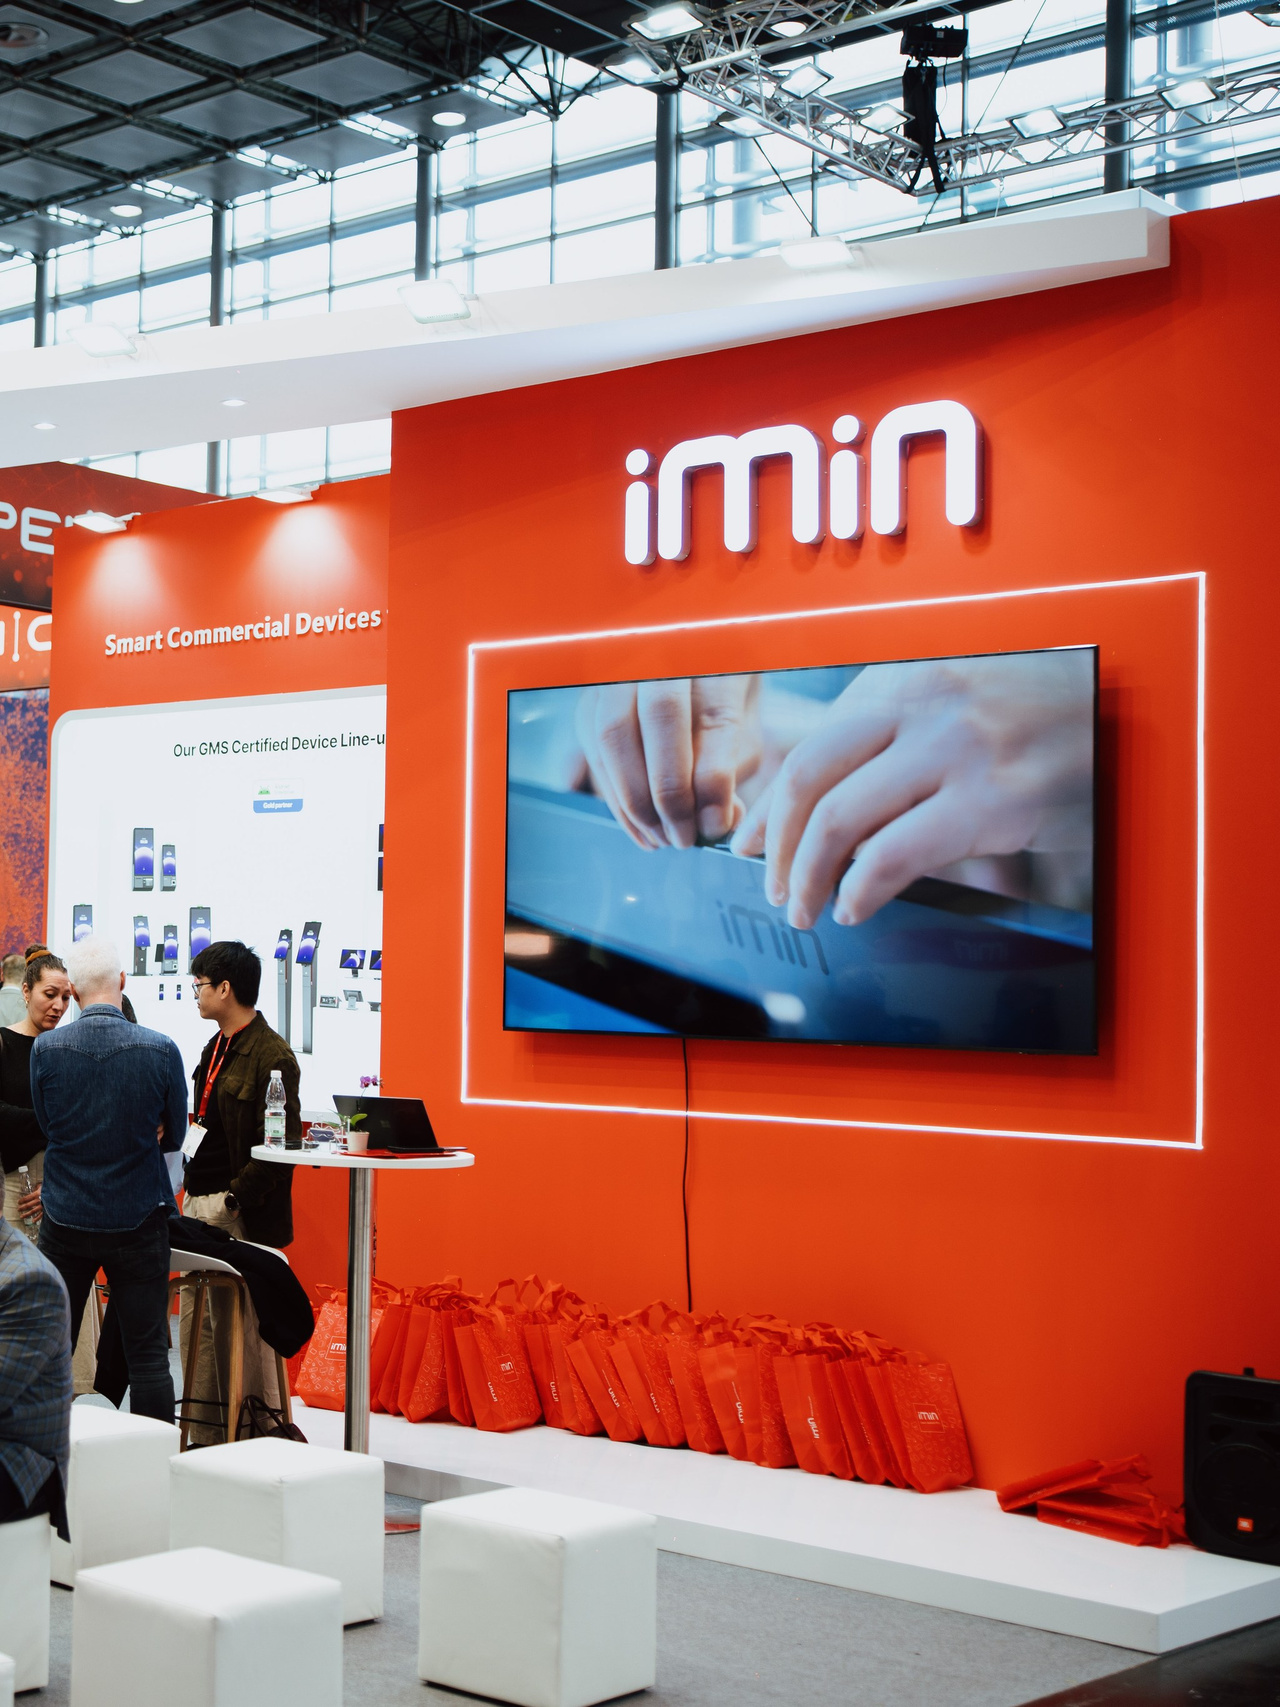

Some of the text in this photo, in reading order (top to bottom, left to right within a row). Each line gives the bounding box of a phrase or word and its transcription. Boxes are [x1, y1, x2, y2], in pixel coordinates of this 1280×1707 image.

[625, 400, 982, 565] imin
[105, 607, 381, 656] Smart Commercial Devices
[173, 744, 196, 757] Our
[199, 740, 229, 755] GMS
[232, 737, 289, 754] Certified
[292, 734, 337, 750] Device
